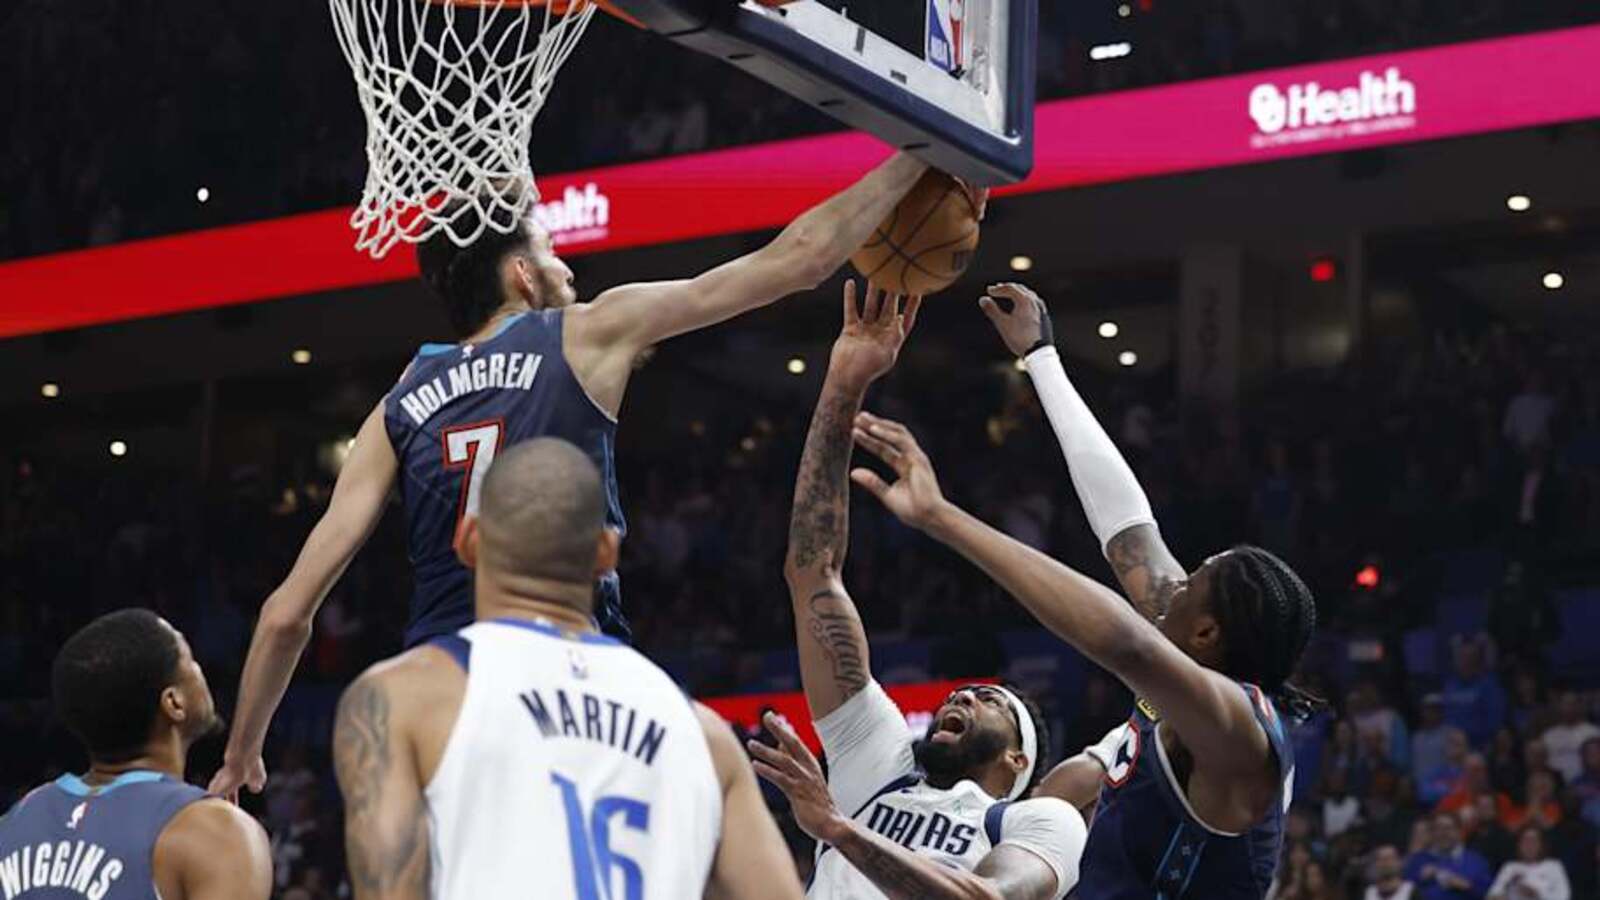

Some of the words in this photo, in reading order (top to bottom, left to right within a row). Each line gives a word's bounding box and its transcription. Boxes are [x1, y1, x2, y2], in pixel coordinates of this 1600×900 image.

[1288, 67, 1415, 128] Health
[400, 352, 543, 425] HOLMGREN
[442, 416, 505, 522] 7
[519, 689, 667, 767] MARTIN
[0, 837, 124, 900] WIGGINS
[549, 770, 652, 900] 16
